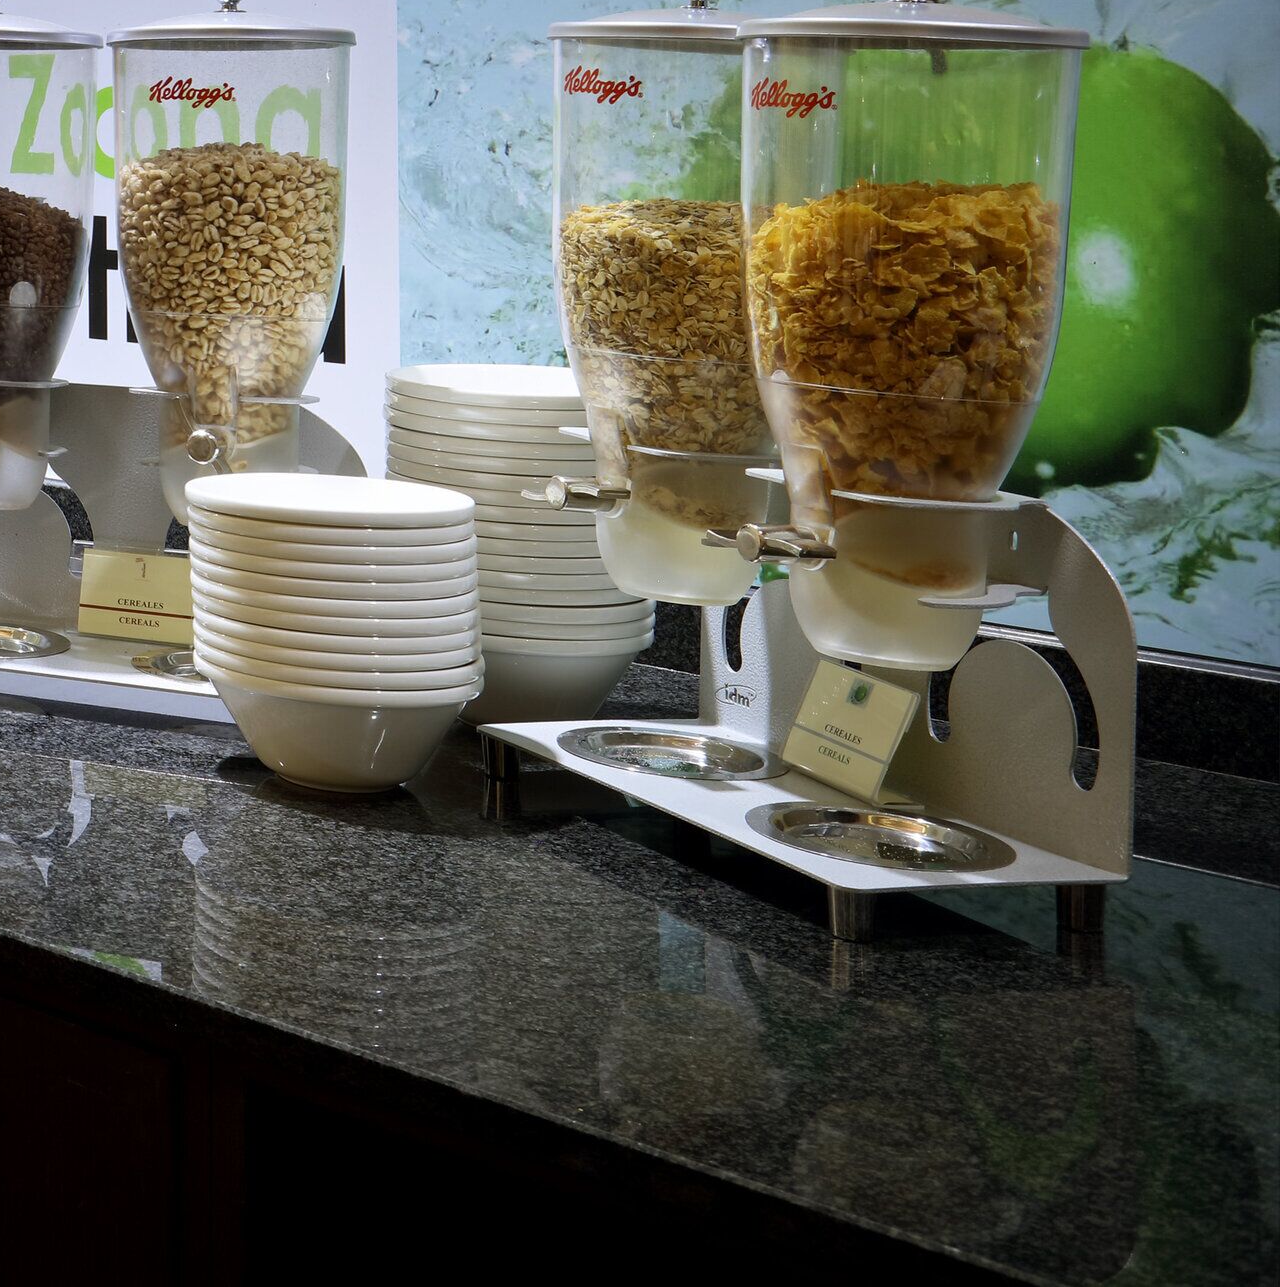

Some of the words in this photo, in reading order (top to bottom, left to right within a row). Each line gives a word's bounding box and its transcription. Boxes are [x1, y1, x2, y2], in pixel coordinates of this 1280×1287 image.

[149, 76, 236, 109] Kellogg's
[564, 65, 642, 105] Kellogg's
[751, 77, 836, 119] Kellogg's
[117, 598, 165, 610] CEREALES
[118, 616, 161, 628] CEREALS
[724, 683, 751, 708] idm
[824, 723, 863, 746] CEREALES
[817, 745, 851, 766] CEREALS
